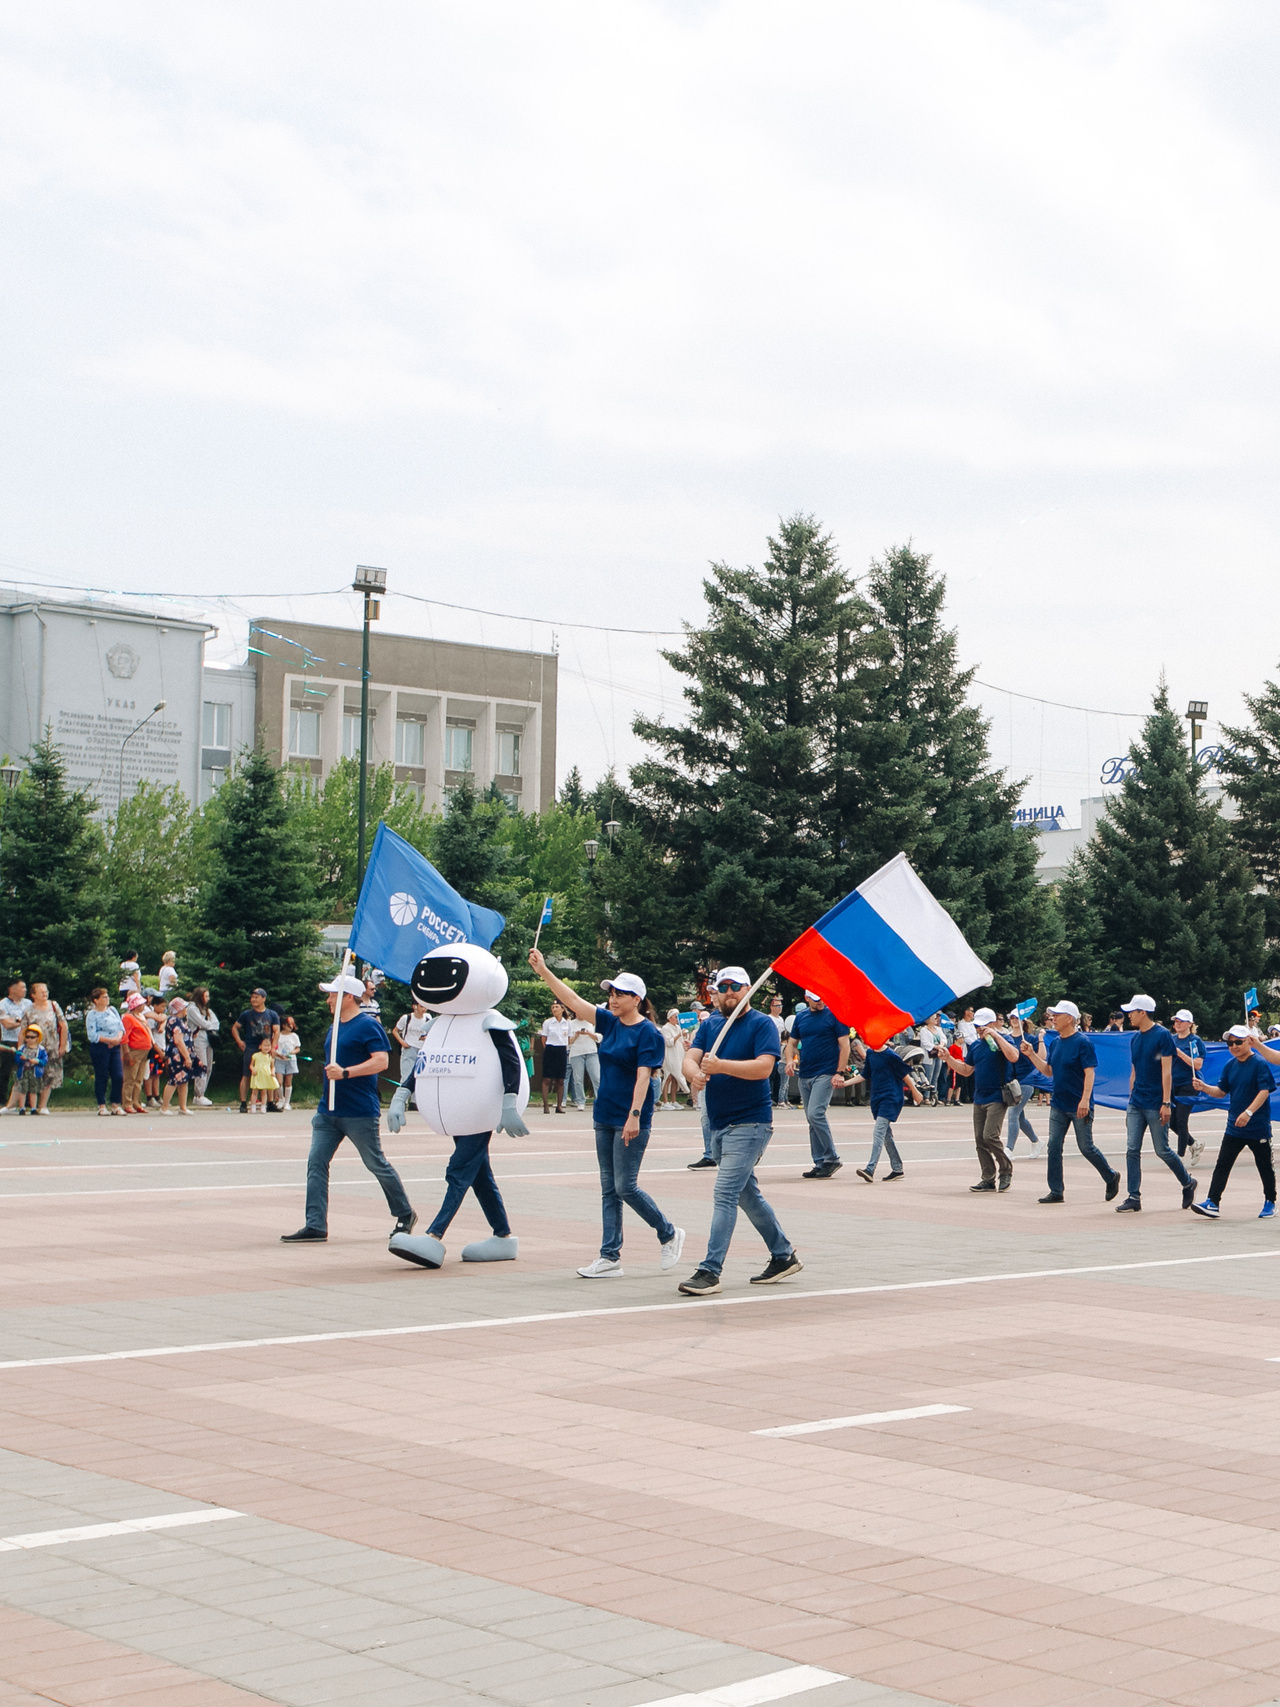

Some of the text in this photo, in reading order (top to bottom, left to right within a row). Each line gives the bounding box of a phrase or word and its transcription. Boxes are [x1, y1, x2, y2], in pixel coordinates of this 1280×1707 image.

[107, 697, 136, 710] УКАЗ
[1012, 805, 1065, 821] ИНИЦА
[421, 905, 468, 944] РОССЕТИ
[430, 1054, 477, 1065] РОССЕТИ
